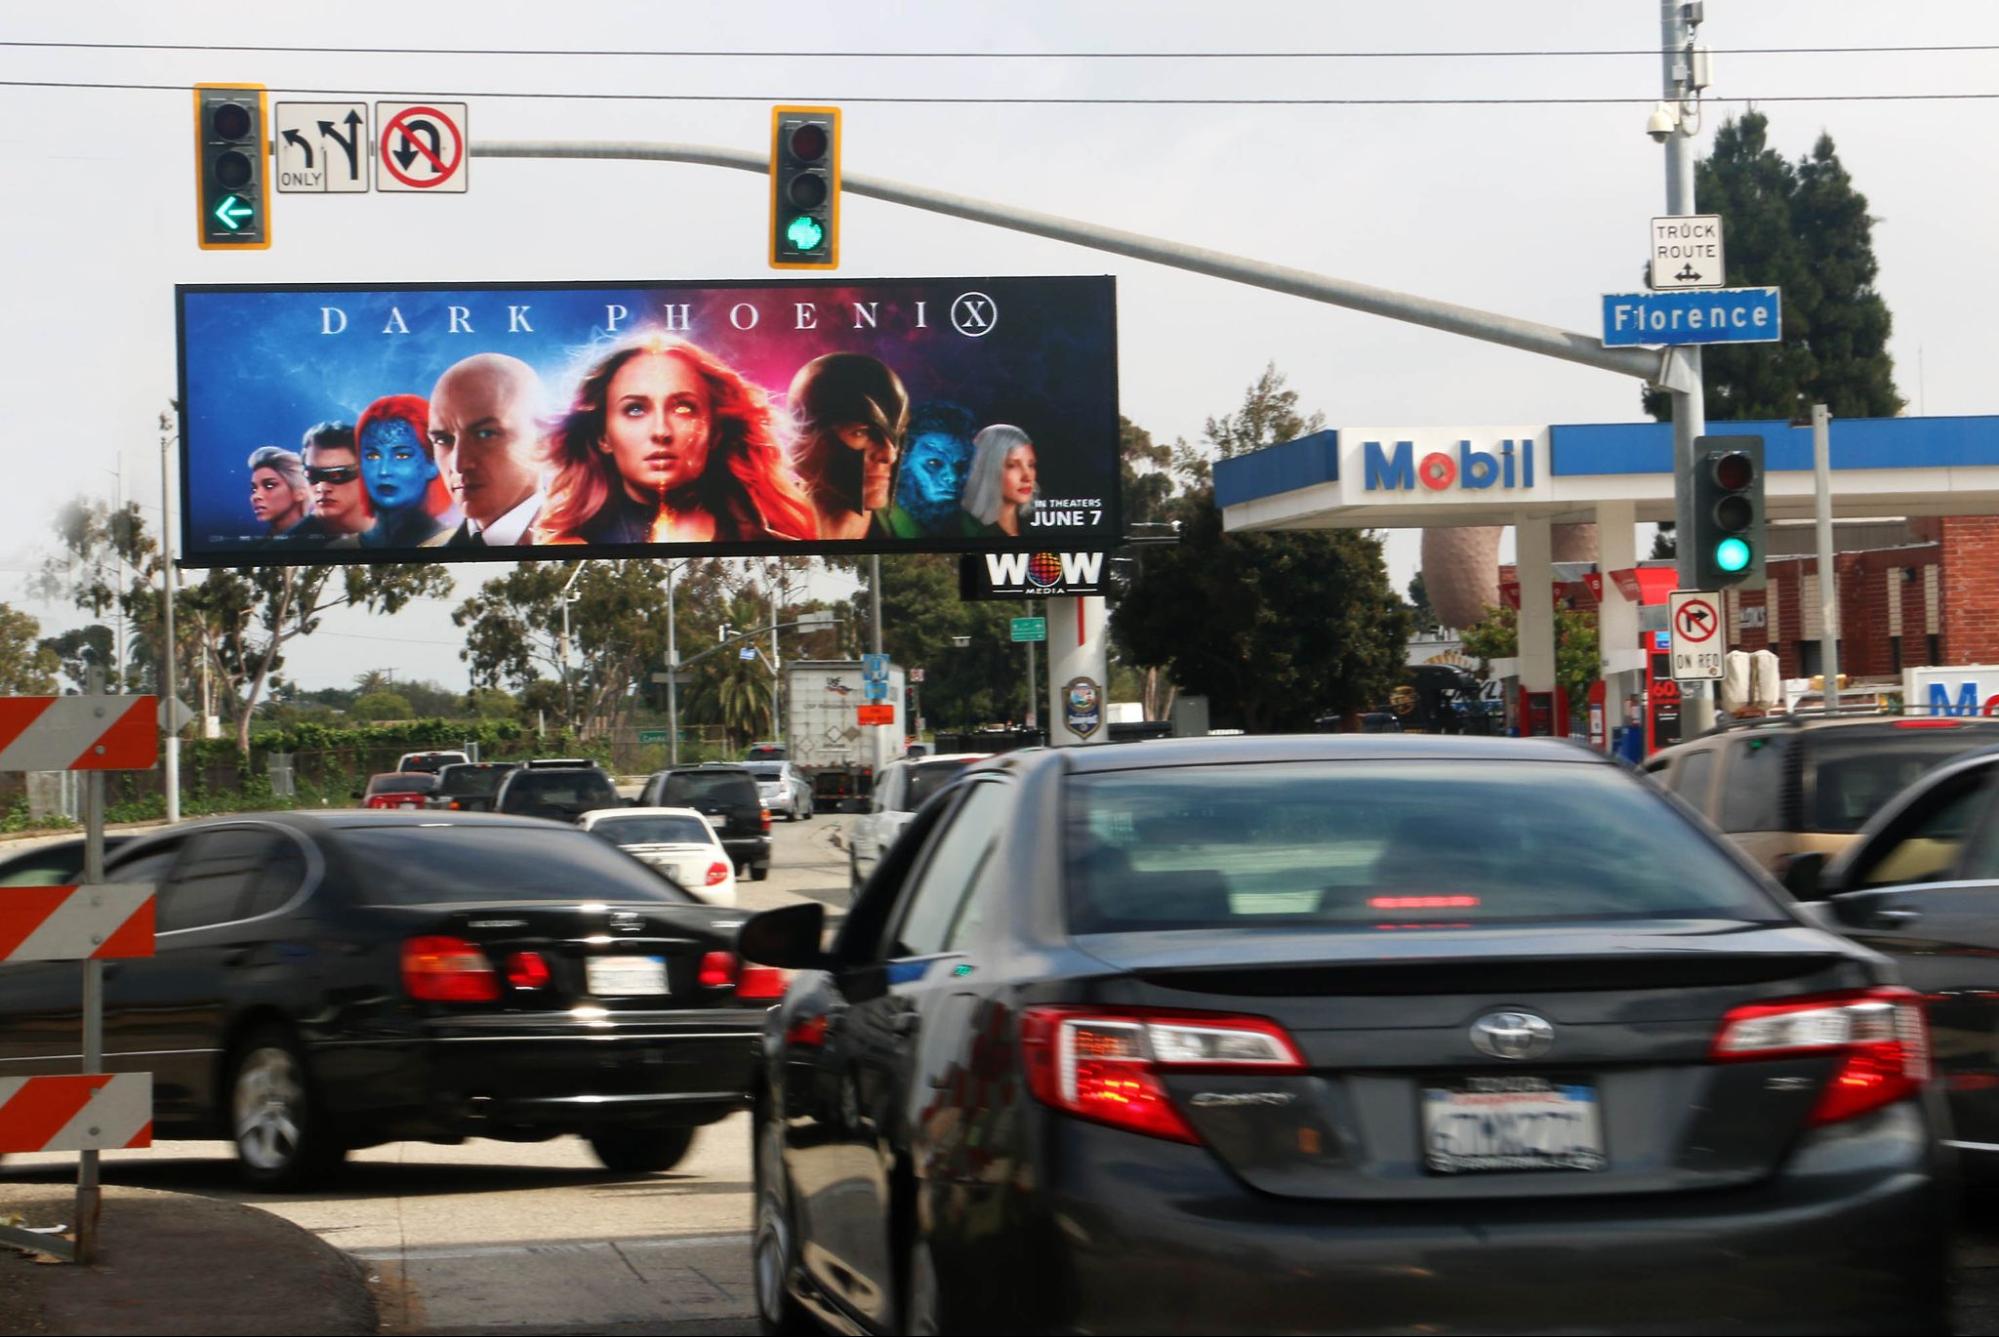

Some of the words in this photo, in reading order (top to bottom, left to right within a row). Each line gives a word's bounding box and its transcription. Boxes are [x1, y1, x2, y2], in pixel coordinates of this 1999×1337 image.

[281, 172, 322, 186] ONLY
[1657, 224, 1716, 239] TRUCK
[1657, 244, 1716, 259] ROUTE
[320, 305, 535, 335] DARK
[606, 296, 994, 335] PHOENIX
[1614, 304, 1768, 331] Florence
[1364, 439, 1534, 490] Mobil
[1034, 499, 1047, 508] IN
[1050, 498, 1102, 508] THEATERS
[1030, 511, 1085, 527] JUNE
[1090, 510, 1102, 526] 7
[985, 552, 1104, 588] WOW
[1676, 654, 1692, 669] ON
[1698, 653, 1719, 669] RED
